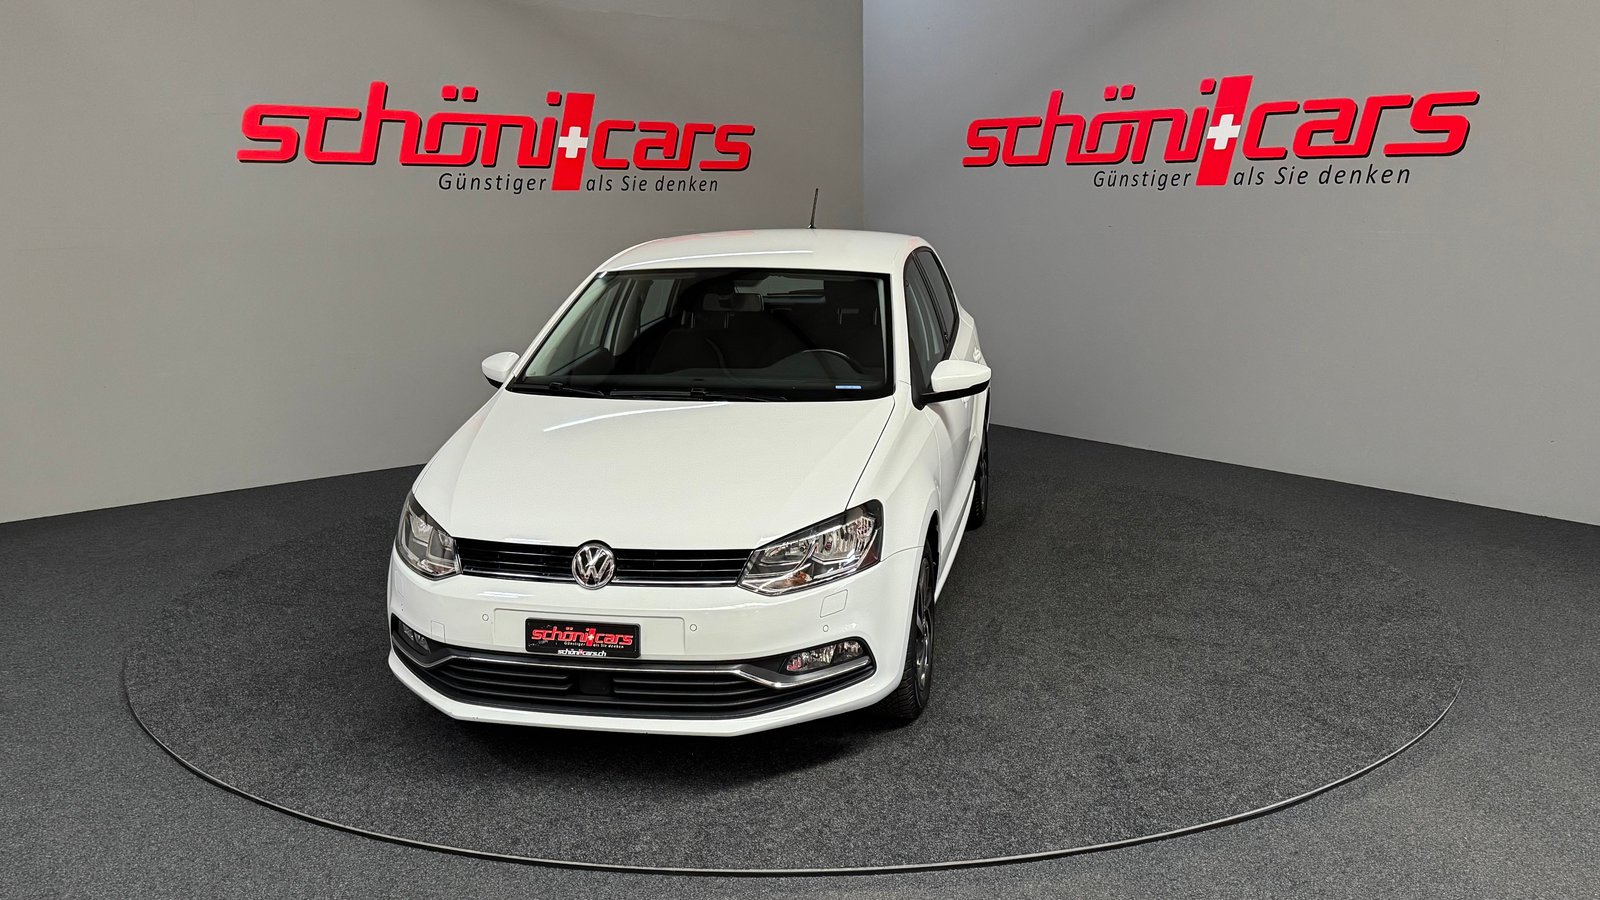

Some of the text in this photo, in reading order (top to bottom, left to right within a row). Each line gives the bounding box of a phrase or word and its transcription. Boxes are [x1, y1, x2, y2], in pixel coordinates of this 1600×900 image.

[438, 173, 719, 195] Günstiger als Sie denken
[1093, 163, 1411, 191] Günstiger als Sie denken
